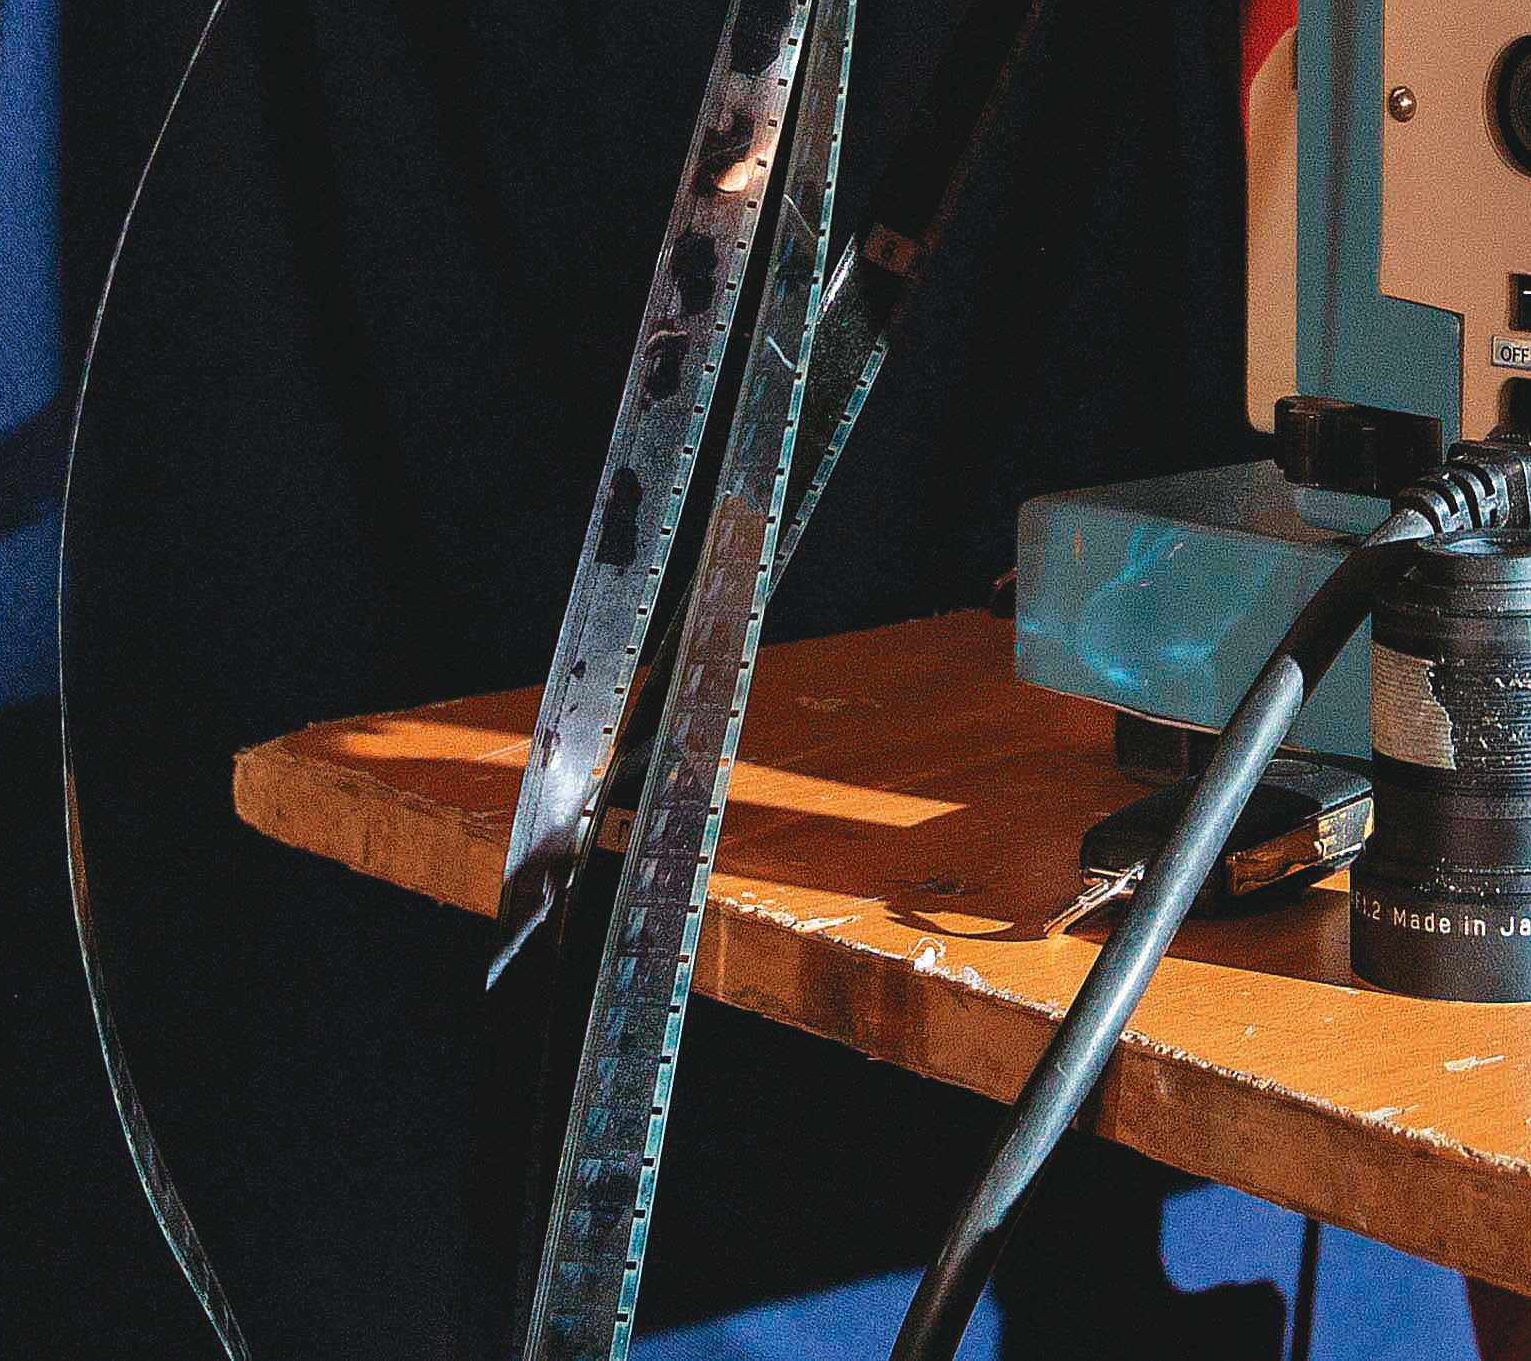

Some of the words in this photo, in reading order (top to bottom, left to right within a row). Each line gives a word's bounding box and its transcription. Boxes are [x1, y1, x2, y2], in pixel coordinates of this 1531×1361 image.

[1500, 345, 1530, 363] OFF
[1393, 906, 1451, 934] Made
[1464, 915, 1486, 936] in
